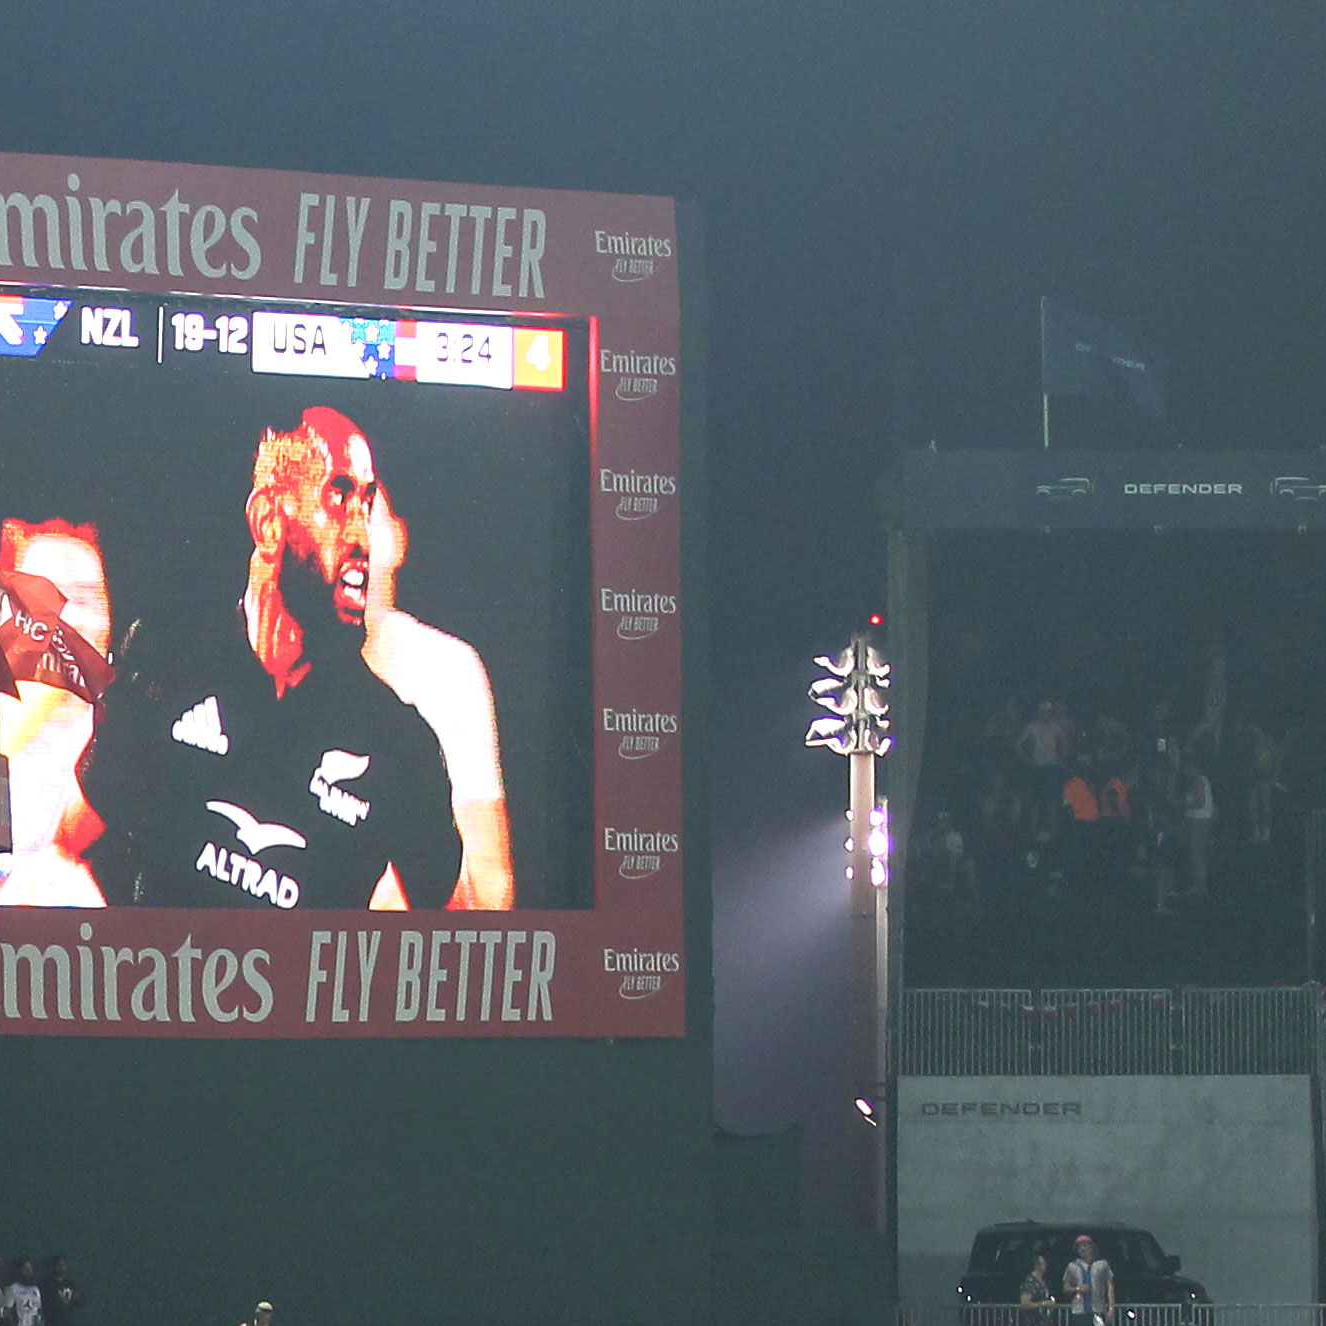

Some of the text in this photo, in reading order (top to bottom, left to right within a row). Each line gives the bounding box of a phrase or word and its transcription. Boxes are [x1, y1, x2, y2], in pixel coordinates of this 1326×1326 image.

[293, 192, 370, 289] FLY
[384, 199, 547, 299] BETTER
[595, 230, 672, 258] Emirates
[81, 306, 140, 348] NZL
[272, 323, 327, 357] USA
[434, 333, 493, 365] 3:24
[525, 335, 550, 372] 4
[600, 350, 676, 376] Emirates
[600, 469, 676, 495] Emirates
[1124, 484, 1243, 495] DEFENDER
[600, 588, 676, 614] Emirates
[603, 708, 677, 734] Emirates
[604, 828, 678, 853] Emirates
[196, 842, 301, 910] ALTRAD
[604, 948, 679, 973] Emirates
[305, 930, 381, 1023] FLY
[395, 930, 557, 1023] BETTER
[920, 1102, 1082, 1116] DEFENDER
